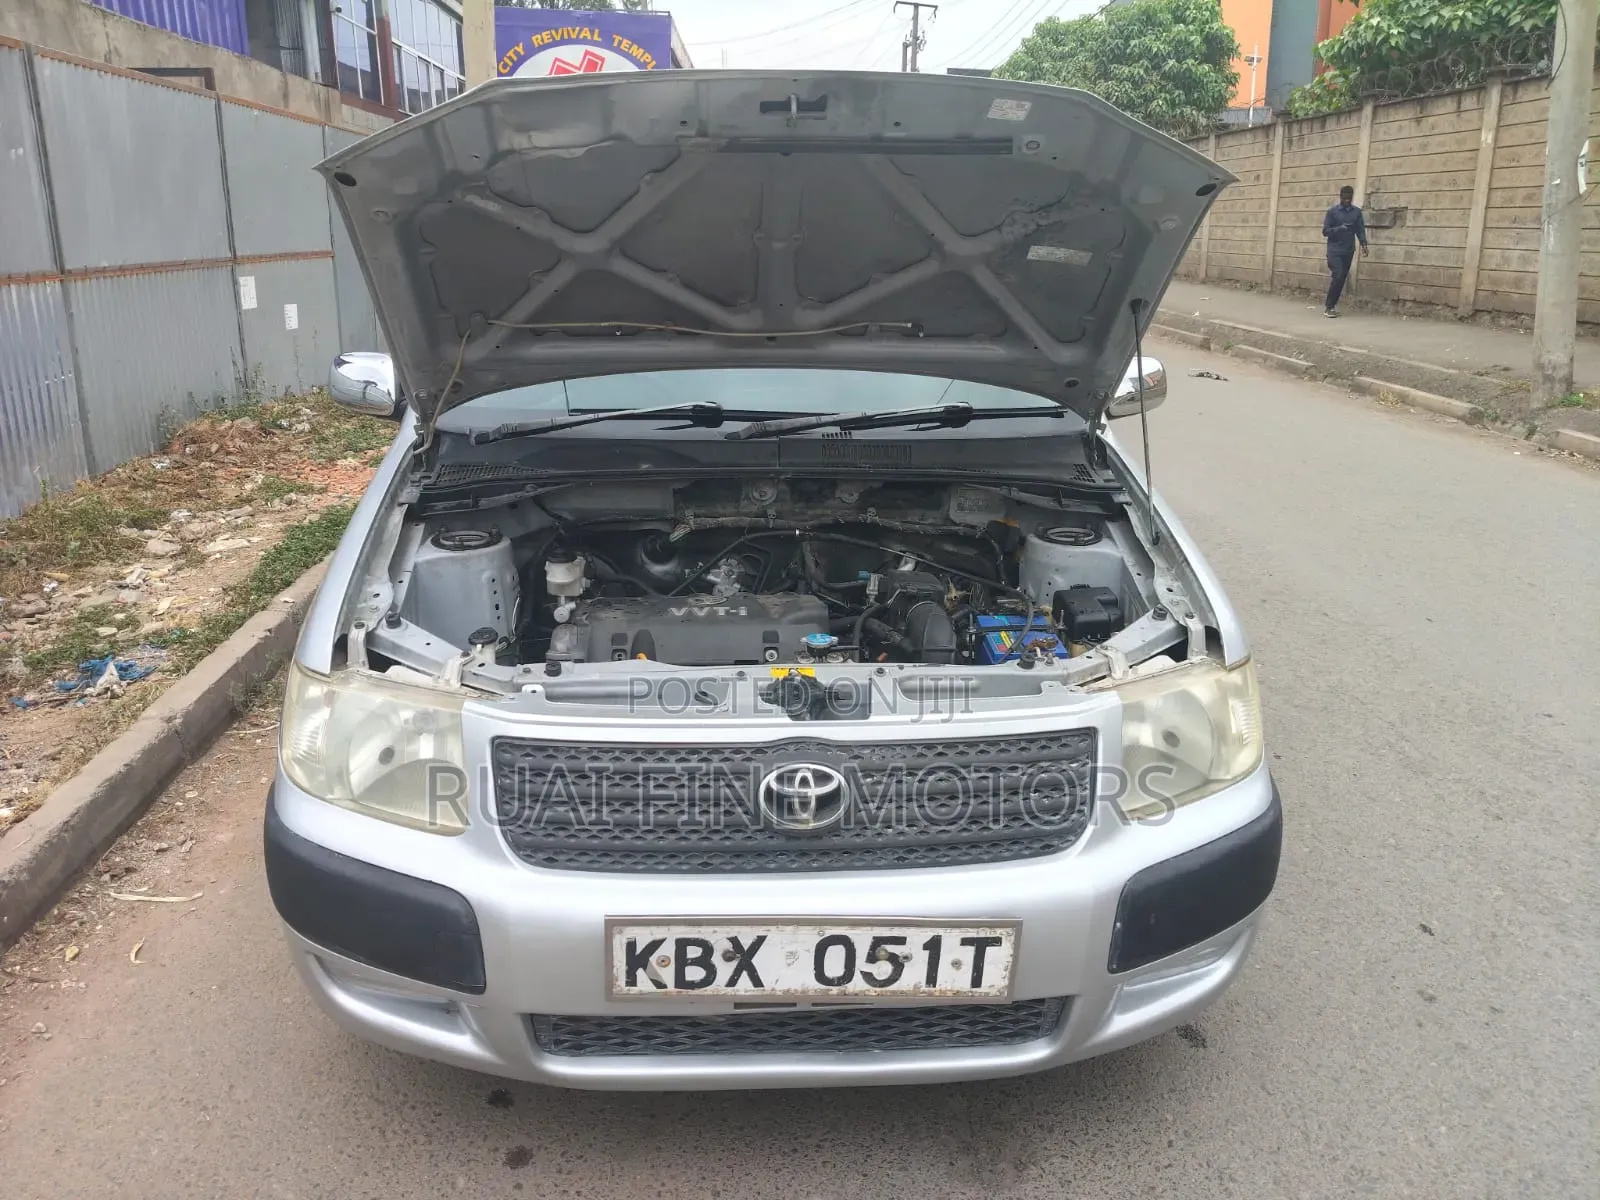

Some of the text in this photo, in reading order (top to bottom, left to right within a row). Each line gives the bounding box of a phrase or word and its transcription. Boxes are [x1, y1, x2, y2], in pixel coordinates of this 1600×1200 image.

[498, 42, 525, 75] CITY
[531, 26, 602, 48] REVIVAL
[625, 934, 1002, 989] KBX 051T
